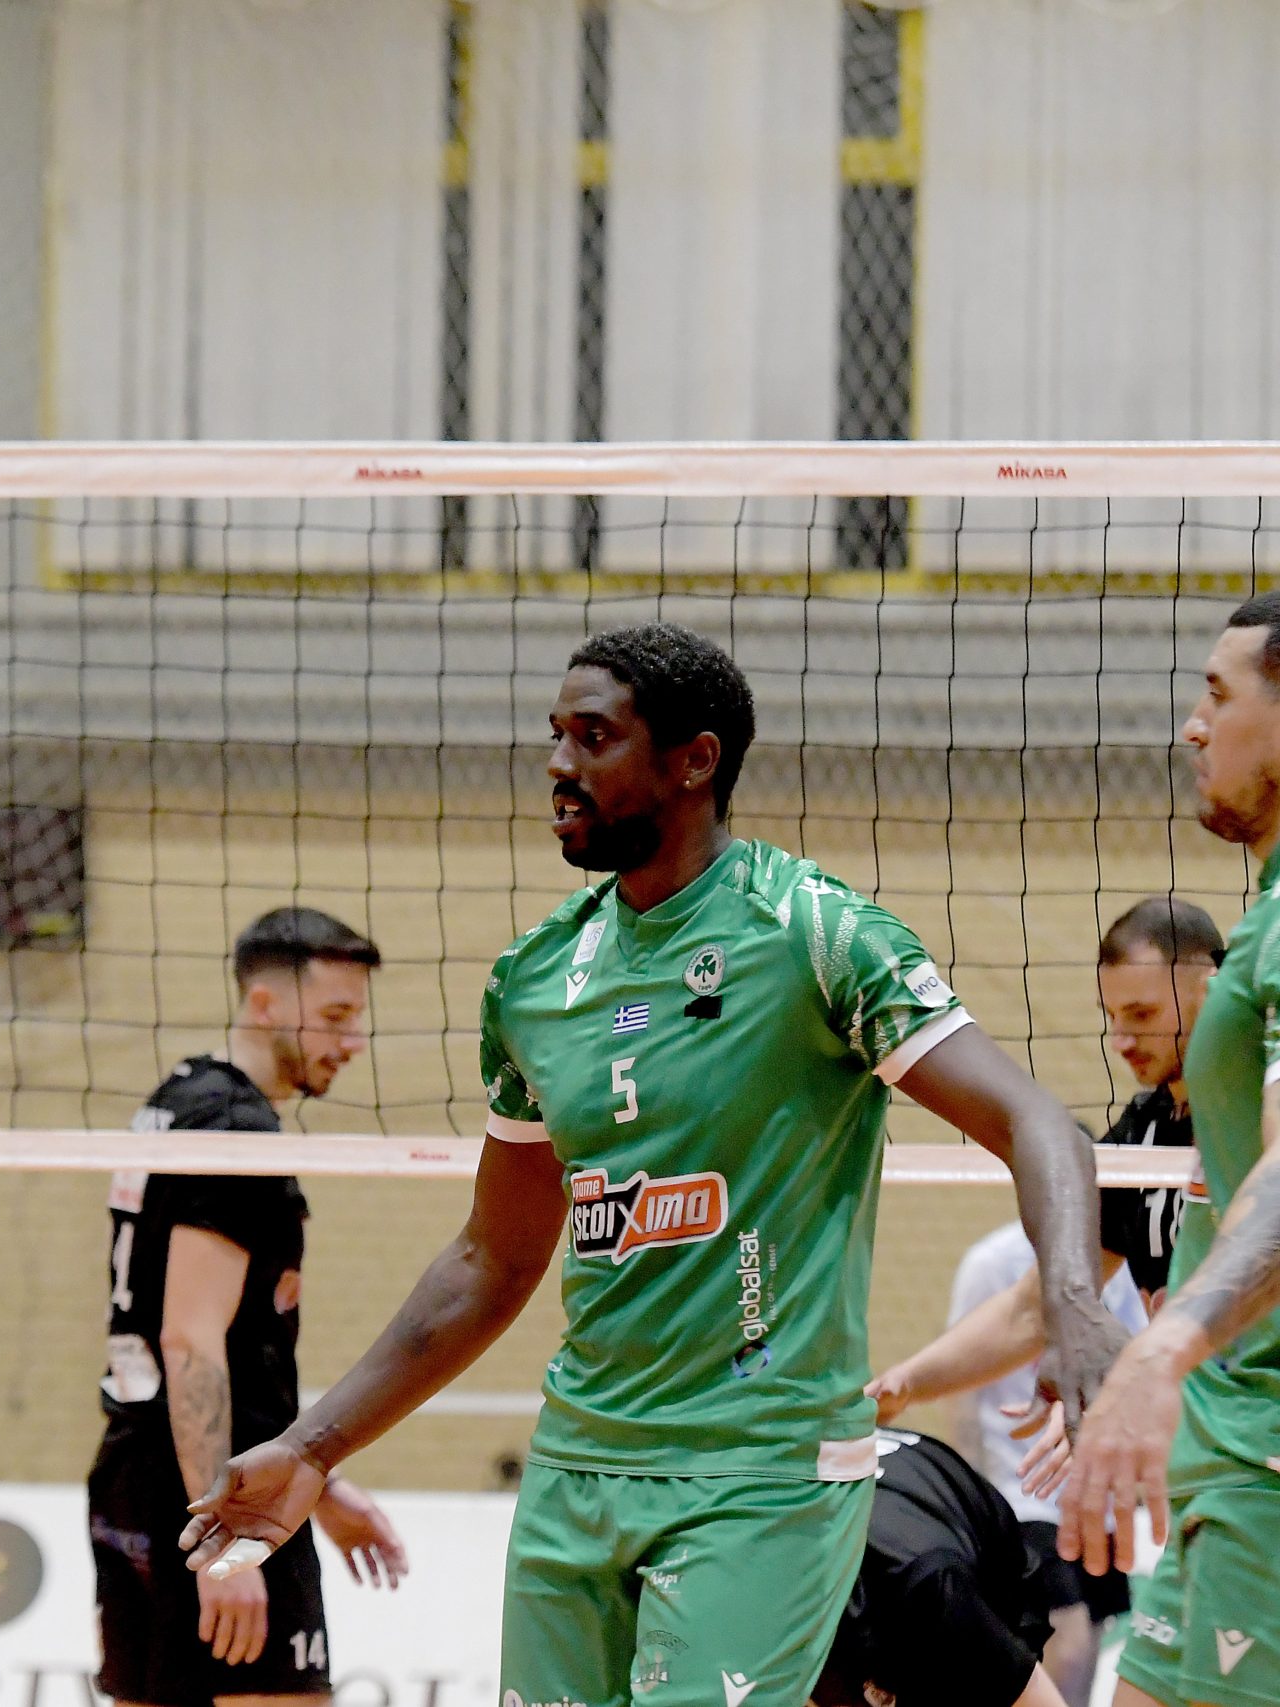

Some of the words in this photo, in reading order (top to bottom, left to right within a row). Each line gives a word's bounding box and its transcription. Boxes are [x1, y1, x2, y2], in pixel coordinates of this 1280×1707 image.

[611, 1056, 638, 1124] 5
[736, 1228, 769, 1341] globalsat
[289, 1630, 326, 1670] 14
